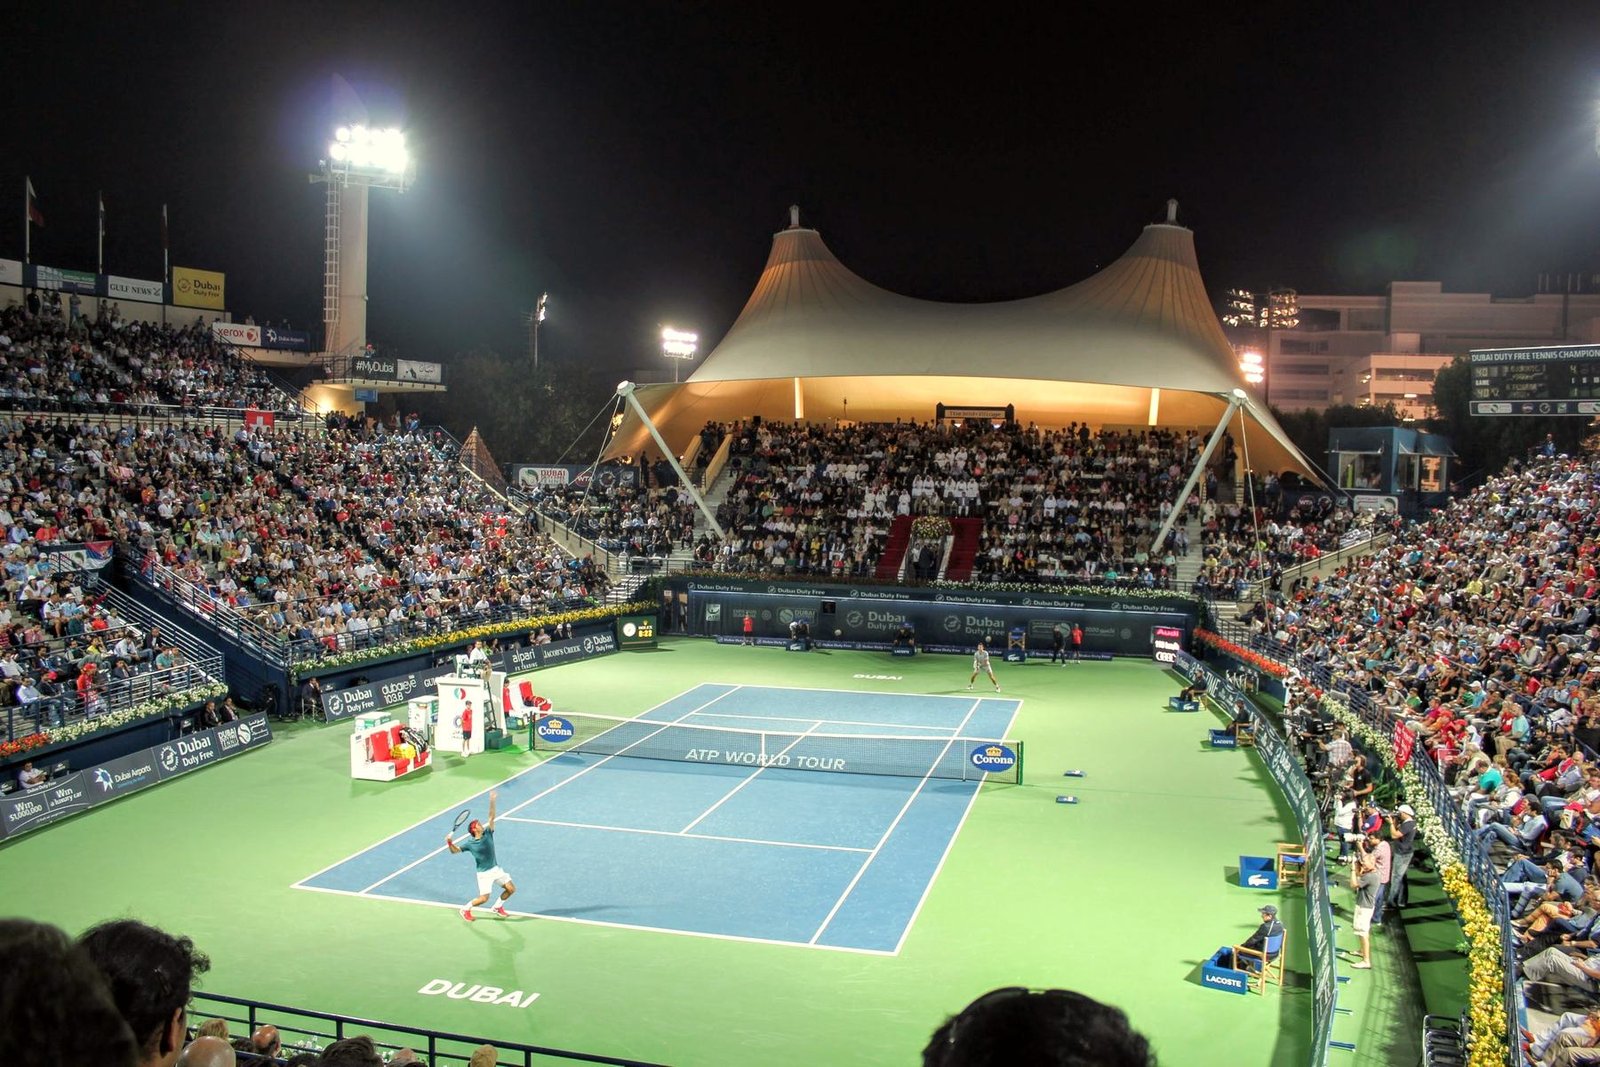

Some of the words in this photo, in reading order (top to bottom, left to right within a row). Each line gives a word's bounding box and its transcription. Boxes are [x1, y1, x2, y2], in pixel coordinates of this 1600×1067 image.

[110, 284, 128, 292] GULF
[132, 286, 151, 296] NEWS
[194, 280, 220, 291] Dubai
[218, 328, 244, 337] xerox
[1472, 354, 1493, 362] DUBAI
[1514, 352, 1530, 360] FREE
[1532, 351, 1557, 359] TENNIS
[1559, 350, 1600, 358] CHAMPION
[356, 360, 394, 374] #MyDubai
[868, 612, 906, 623] Dubai
[966, 616, 1004, 627] Dubai
[868, 622, 886, 631] Duty
[966, 627, 984, 635] Duty
[1157, 629, 1179, 637] Audi
[593, 634, 611, 645] Dubai
[596, 645, 605, 653] Duty
[512, 648, 535, 665] alpari
[343, 689, 372, 703] Dubai
[384, 692, 404, 704] 103.8
[347, 704, 361, 713] Duty
[362, 700, 375, 708] Free
[538, 725, 572, 737] Corona
[178, 737, 211, 755] Dubai
[182, 756, 199, 766] Duty
[200, 750, 214, 761] Free
[685, 749, 719, 760] ATP
[726, 751, 791, 766] WORLD
[797, 756, 846, 770] TOUR
[973, 754, 1013, 765] Corona
[114, 772, 131, 782] Dubai
[132, 765, 151, 777] Airports
[56, 788, 73, 798] Win
[14, 801, 34, 812] Win
[55, 795, 73, 806] luxury
[9, 804, 42, 821] $1,000,000
[1206, 974, 1242, 987] LACOSTE
[418, 979, 540, 1008] DUBAI
